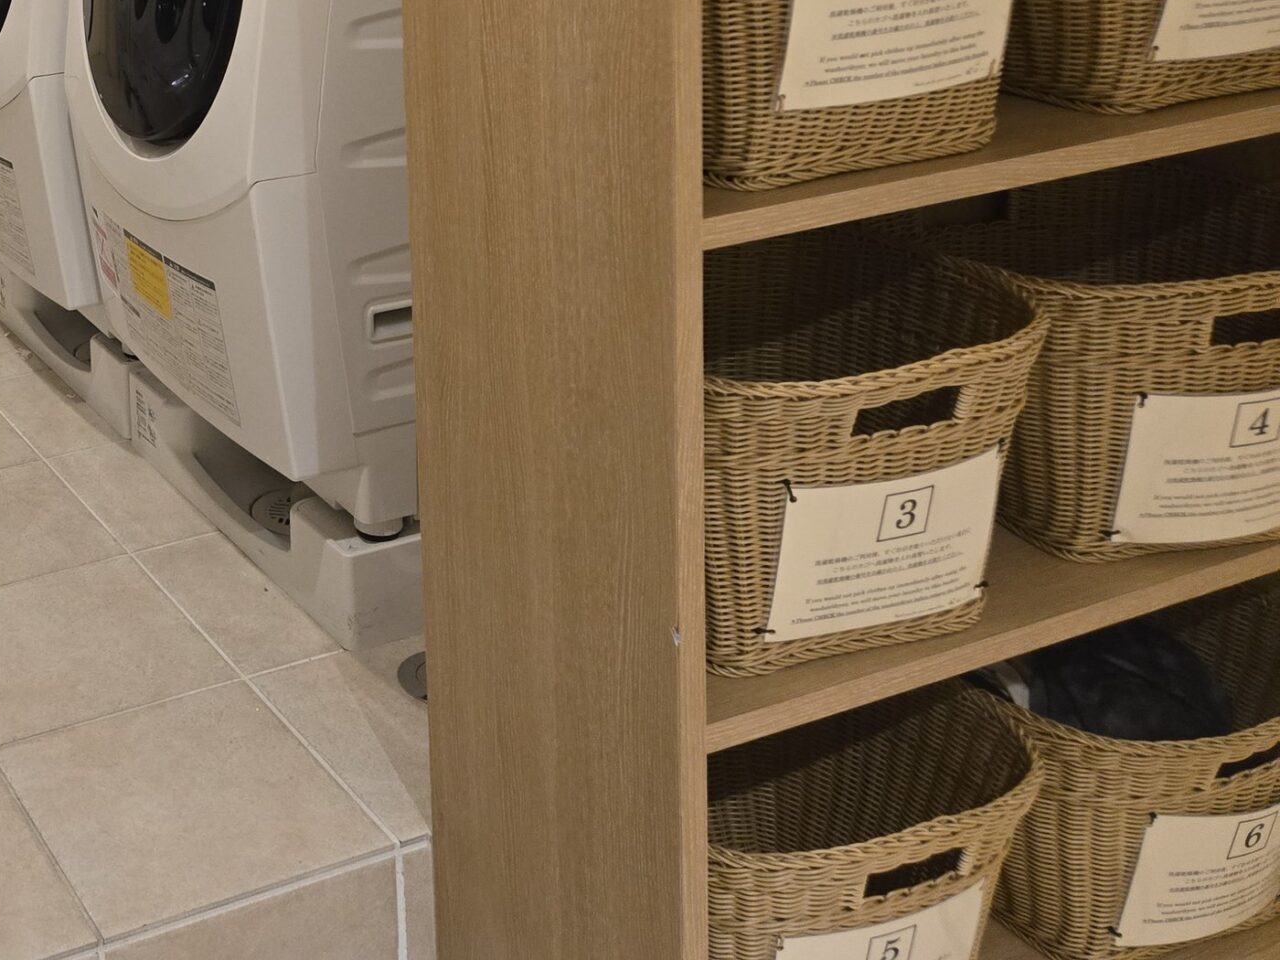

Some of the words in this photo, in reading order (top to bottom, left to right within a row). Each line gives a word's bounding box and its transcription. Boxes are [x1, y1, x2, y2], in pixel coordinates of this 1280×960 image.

[1248, 408, 1270, 436] 4
[896, 499, 917, 530] 3
[1245, 823, 1265, 848] 6
[880, 937, 900, 960] 5
